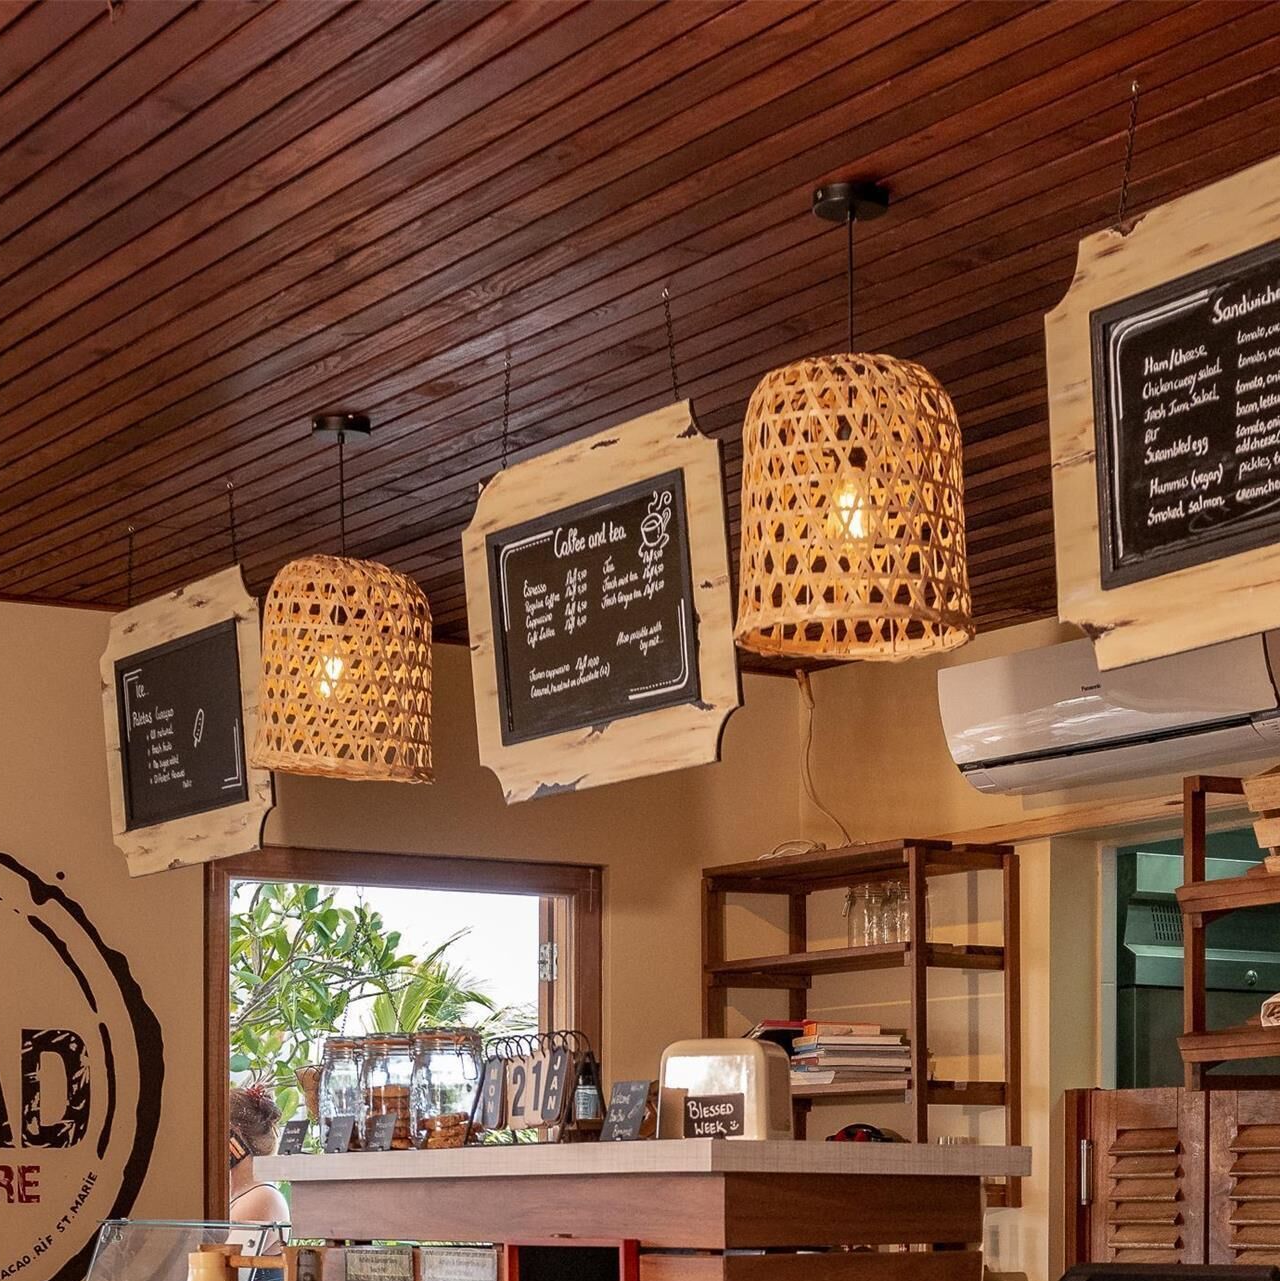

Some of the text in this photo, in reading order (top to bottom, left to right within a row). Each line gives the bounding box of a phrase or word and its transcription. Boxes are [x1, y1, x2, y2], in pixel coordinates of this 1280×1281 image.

[1192, 436, 1209, 456] egg
[546, 1054, 562, 1111] JAN
[694, 1120, 727, 1135] WEEK
